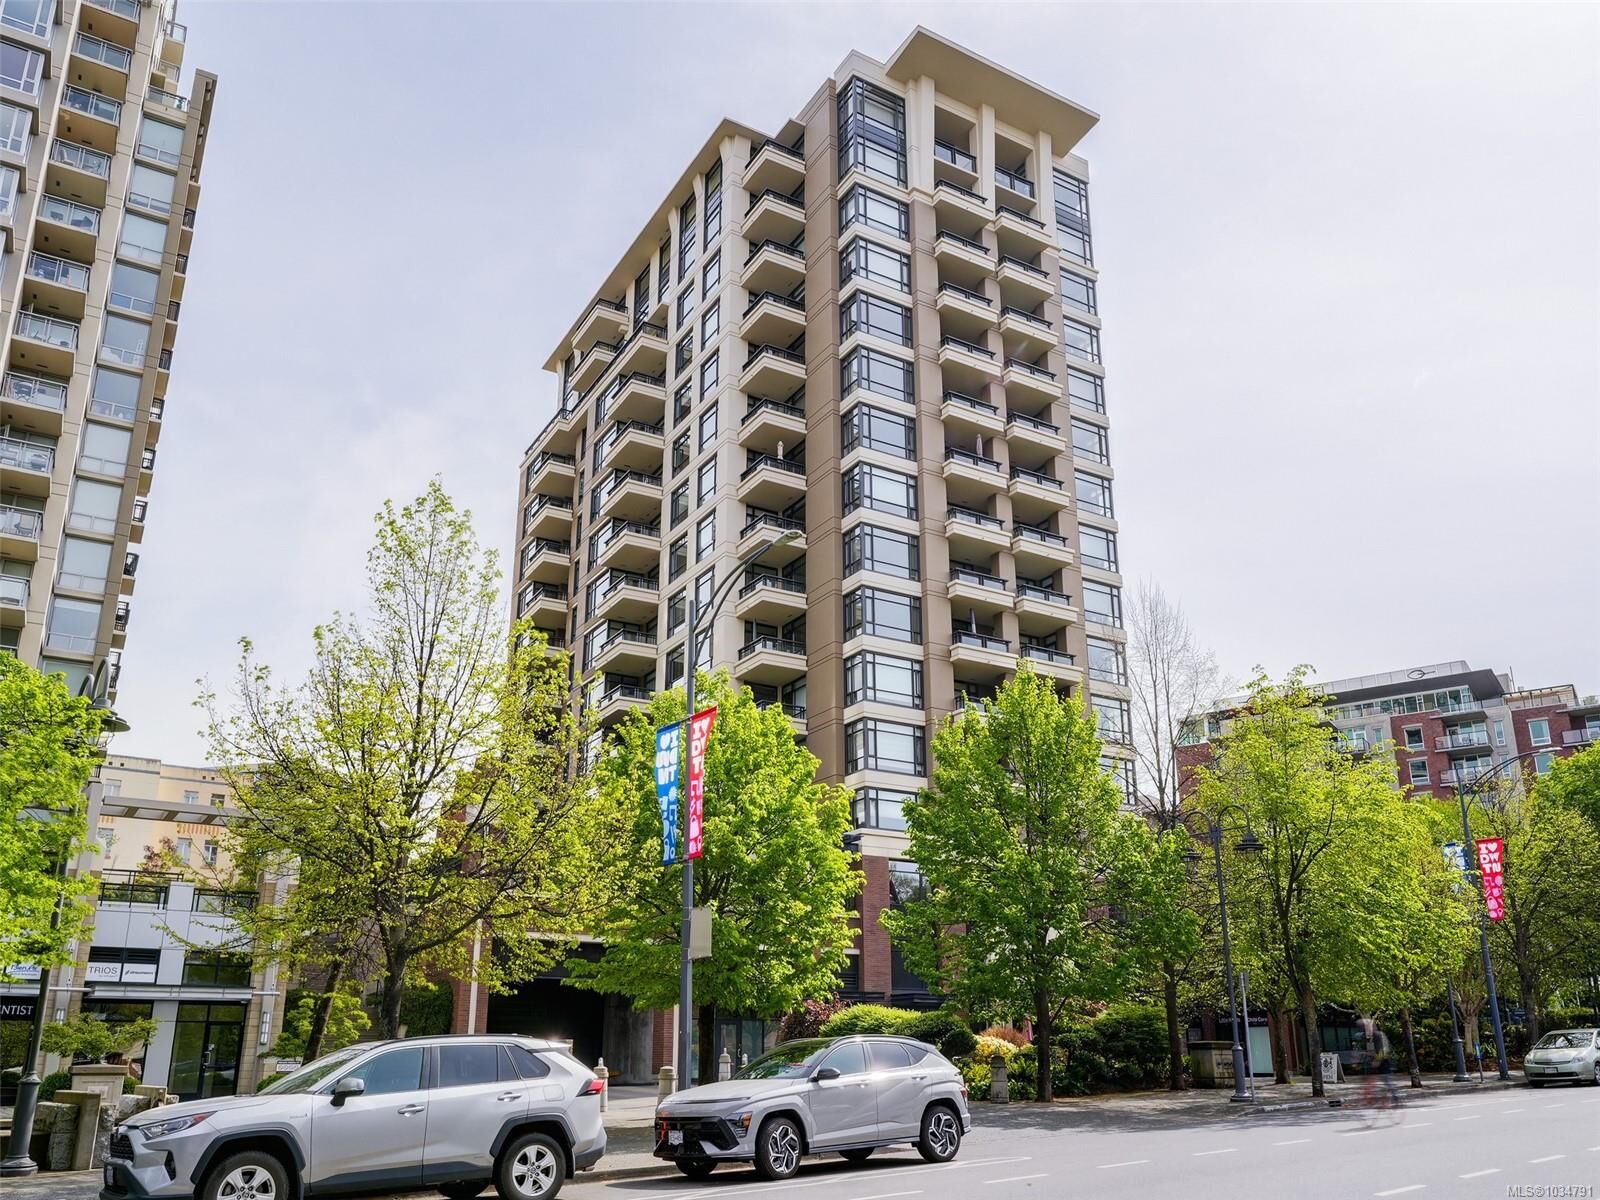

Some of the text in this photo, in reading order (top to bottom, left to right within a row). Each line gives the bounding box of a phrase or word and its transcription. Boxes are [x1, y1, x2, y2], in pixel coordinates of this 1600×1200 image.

[1479, 853, 1500, 864] DW
[1482, 863, 1501, 873] TN
[89, 966, 118, 975] TRIOS
[0, 1005, 34, 1016] NTIST
